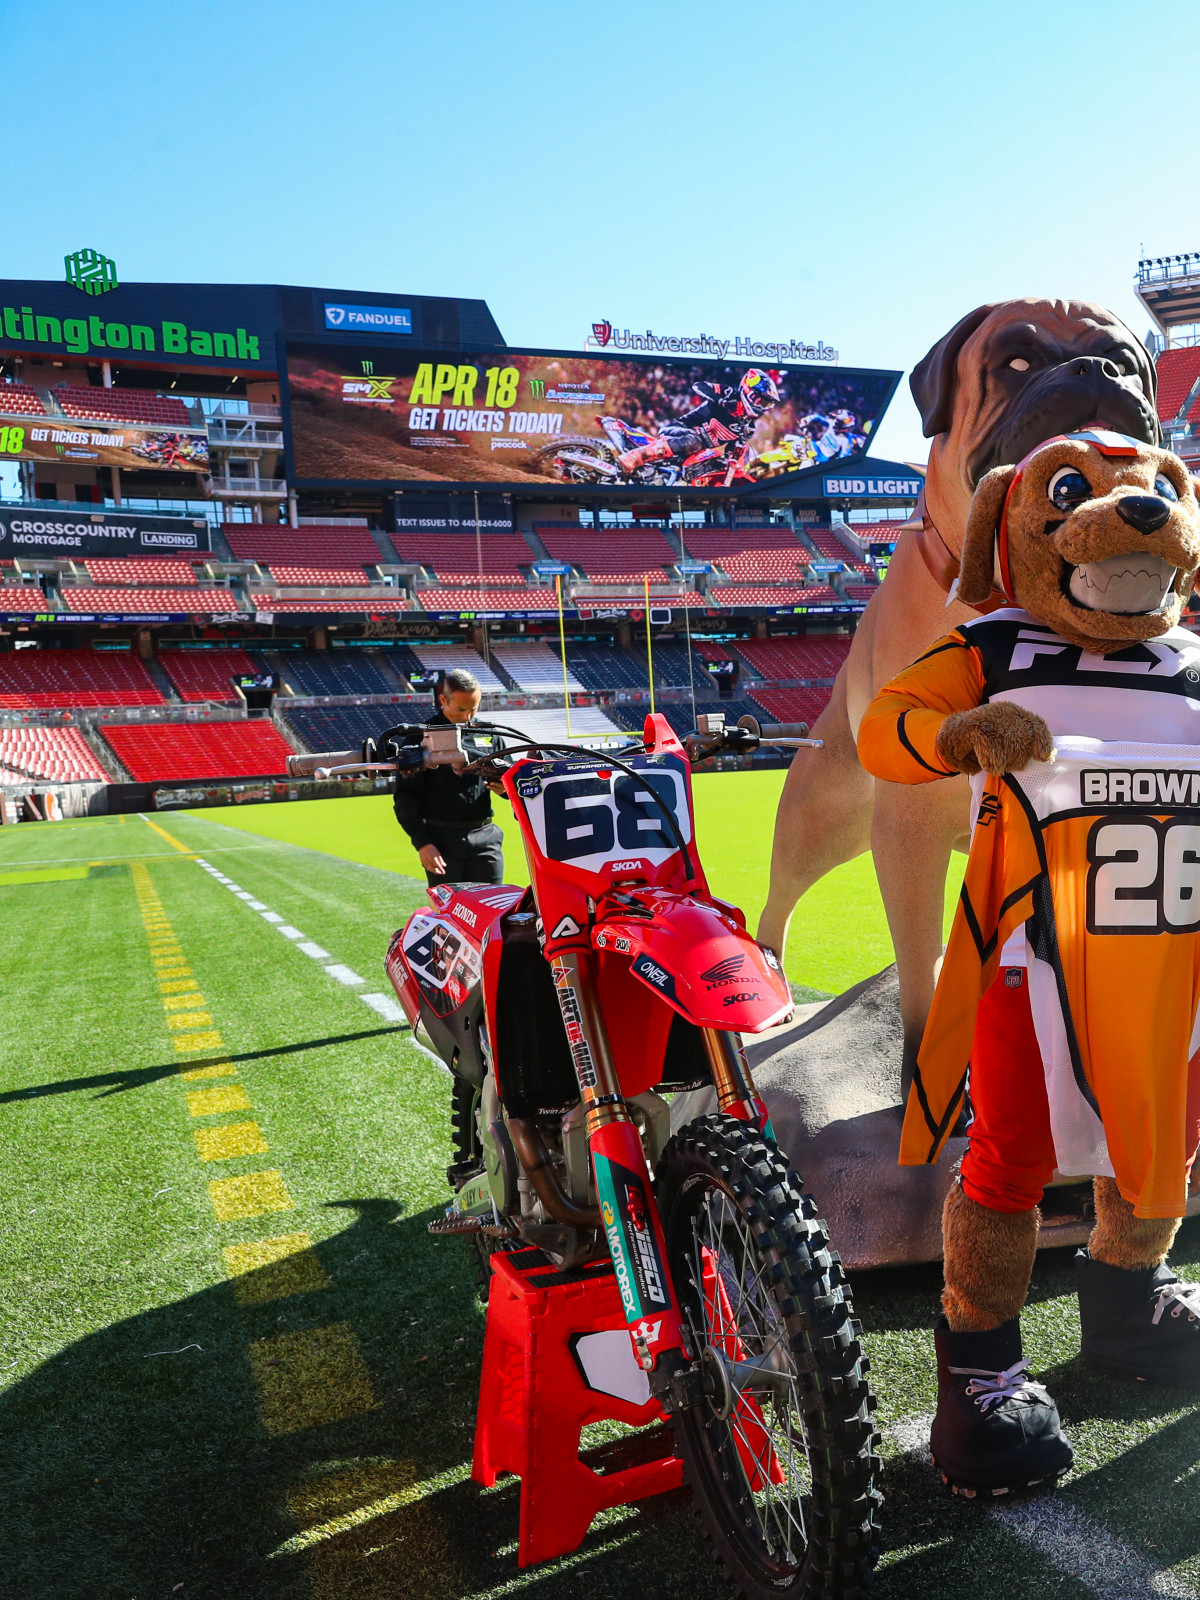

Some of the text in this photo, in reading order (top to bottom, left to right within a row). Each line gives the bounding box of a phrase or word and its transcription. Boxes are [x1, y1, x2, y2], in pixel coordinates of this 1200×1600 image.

[348, 312, 411, 326] FANDUEL
[162, 320, 260, 361] Bank
[613, 328, 834, 364] University Hospitals
[342, 380, 394, 399] SMX
[408, 363, 520, 409] APR 18
[408, 407, 563, 434] GET TICKETS TODAY!
[0, 426, 25, 454] 18
[30, 428, 124, 446] GET TICKETS TODAY!
[491, 440, 527, 451] peacock
[826, 479, 920, 495] BUD LIGHT
[10, 520, 137, 539] CROSSCOUNTRY
[397, 518, 512, 528] TEXT ISSUES TO 440-824-6000
[12, 533, 194, 547] MORTGAGE LANDING
[567, 760, 634, 771] SUPERMOTOSS
[544, 774, 681, 862] 68
[611, 860, 643, 872] SKDA
[451, 902, 478, 929] HONDA
[405, 924, 462, 981] 68
[390, 957, 409, 988] HGS
[706, 977, 762, 991] HONDA
[723, 992, 762, 1007] SKDA
[671, 1080, 702, 1092] Twin Air
[538, 1107, 559, 1115] Twin
[624, 1184, 666, 1304] ISECO
[626, 1220, 648, 1298] Performance Products
[607, 1226, 637, 1316] MOTOREX
